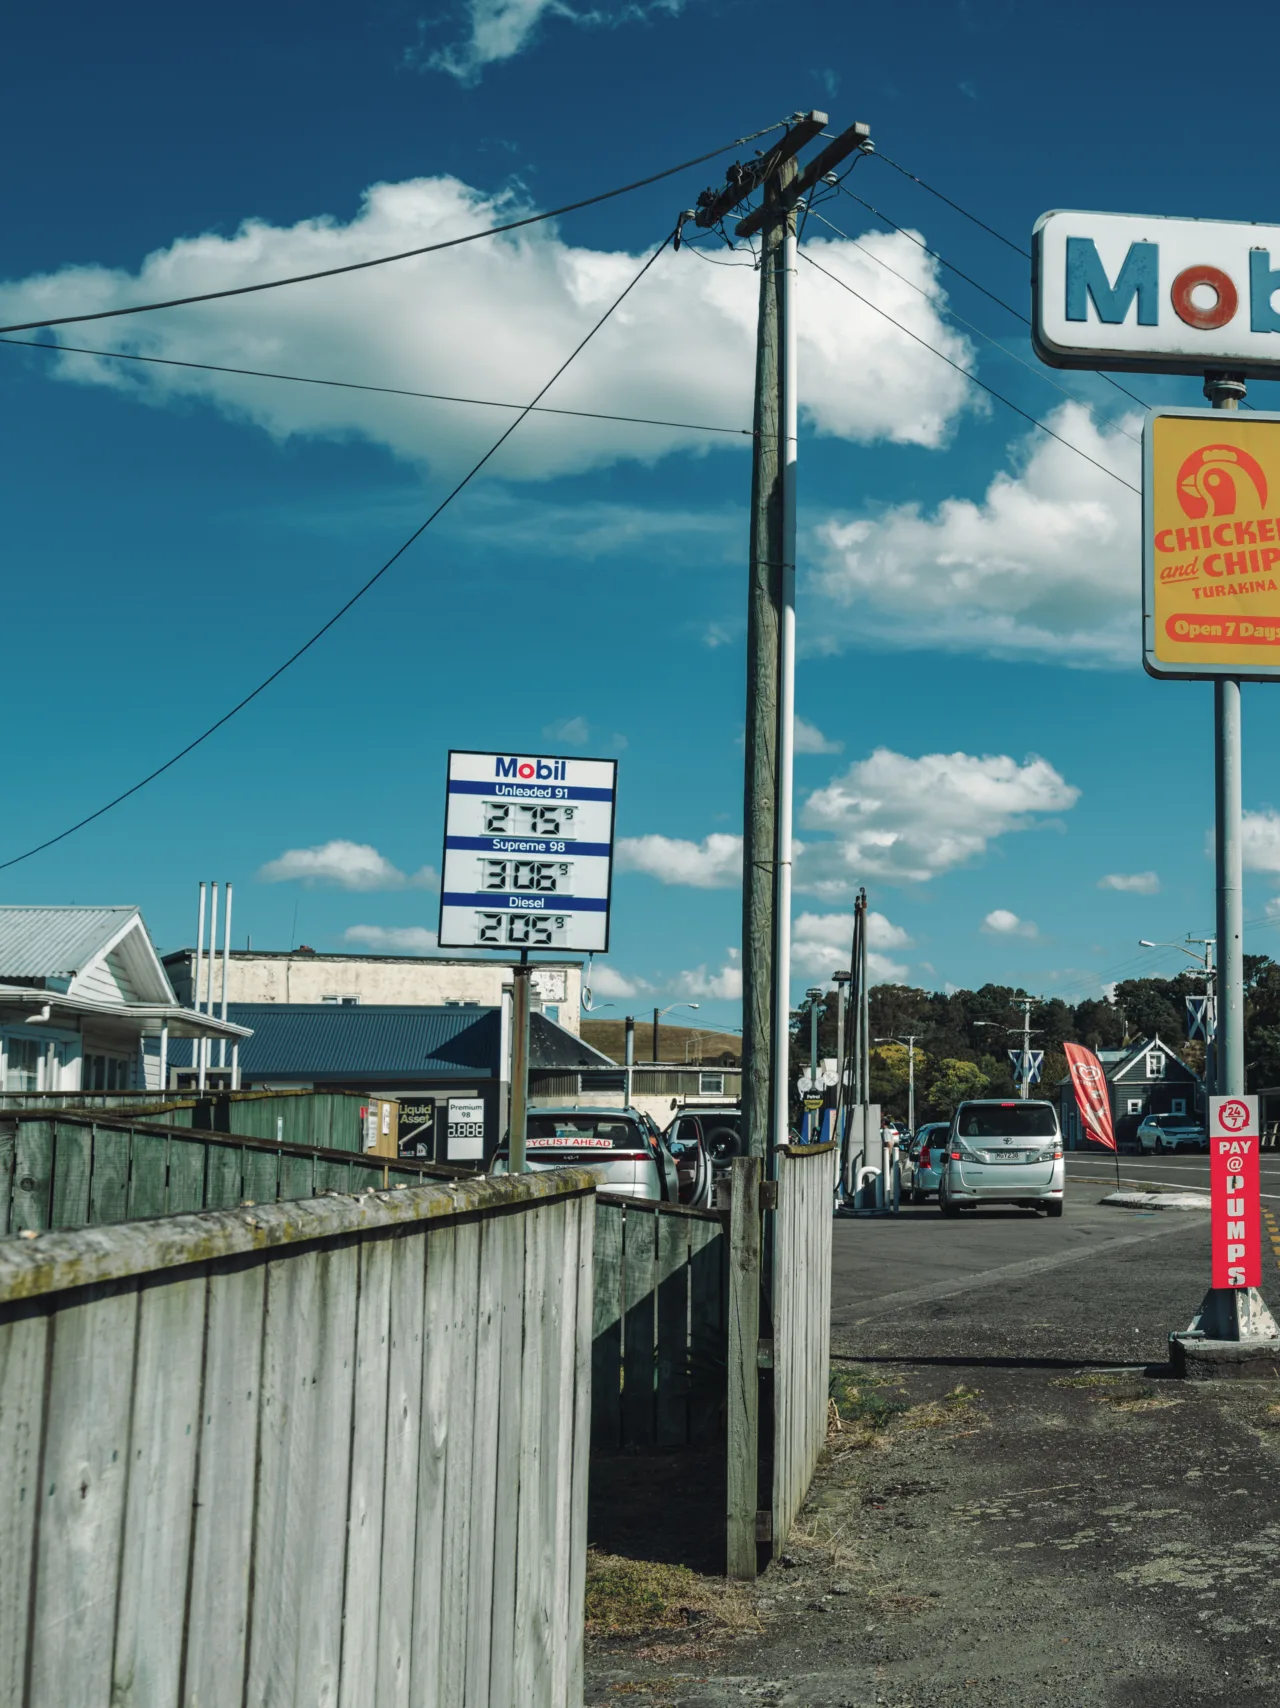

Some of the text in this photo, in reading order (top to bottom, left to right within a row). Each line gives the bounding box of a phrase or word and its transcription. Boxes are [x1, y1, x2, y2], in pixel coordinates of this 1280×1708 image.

[1160, 556, 1199, 582] and
[1192, 579, 1278, 600] TURAKINA
[1174, 620, 1222, 638] Open
[1225, 622, 1236, 637] 7
[495, 757, 566, 781] Mobil
[495, 785, 569, 798] Unleaded 91
[492, 839, 565, 852] Supreme 98
[509, 897, 545, 908] Diesel
[400, 1104, 432, 1115] Liquid
[1227, 1106, 1241, 1117] 24
[400, 1114, 430, 1124] Asset
[1231, 1118, 1238, 1127] 7
[526, 1138, 611, 1147] CYCLIST AHEAD
[1219, 1141, 1252, 1155] PAY
[1226, 1156, 1244, 1172] @
[1226, 1175, 1246, 1286] PUMPS
